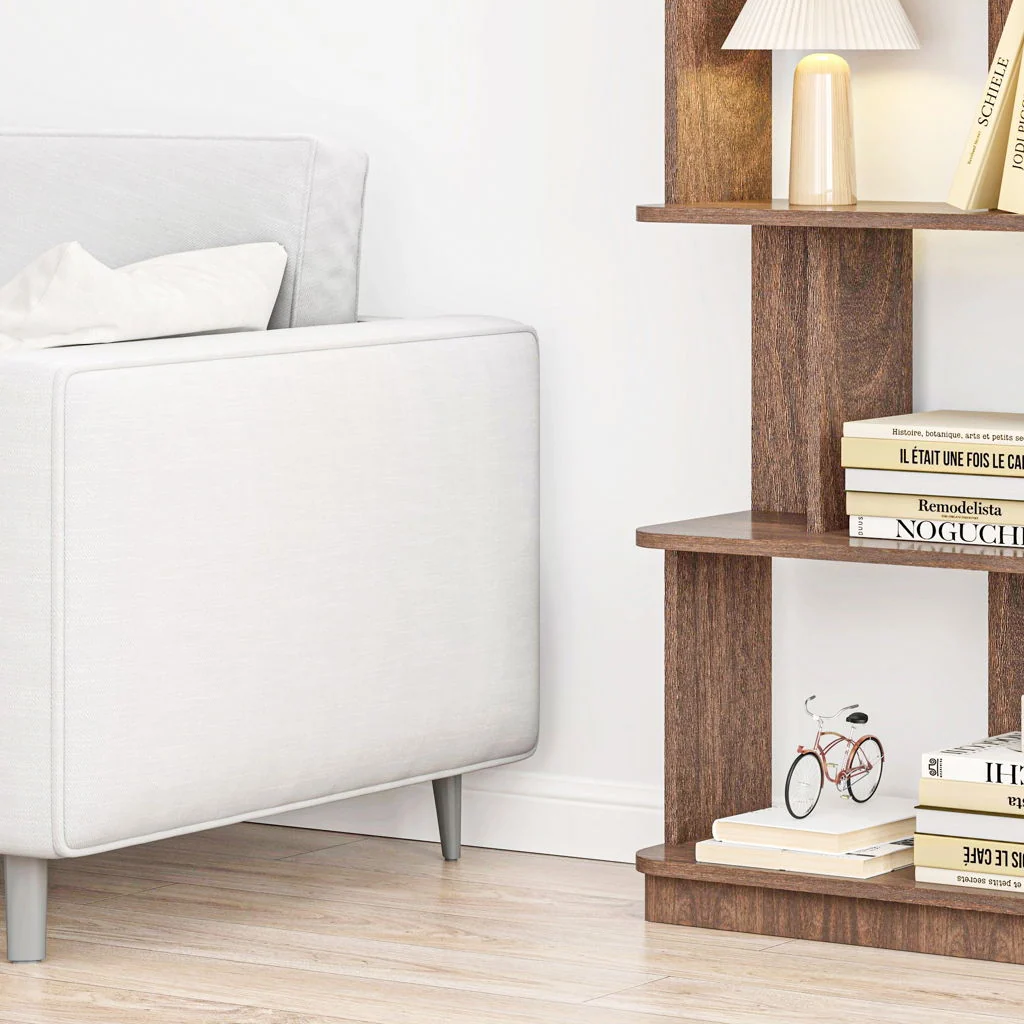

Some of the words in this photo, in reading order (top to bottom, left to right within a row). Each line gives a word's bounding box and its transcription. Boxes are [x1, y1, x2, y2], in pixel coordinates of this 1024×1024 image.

[977, 56, 1009, 127] SCHIELE
[892, 428, 923, 438] Histoire,
[965, 432, 981, 440] arts
[991, 433, 1013, 442] petits
[900, 448, 909, 464] IL
[912, 446, 941, 465] ÉTAIT
[943, 450, 964, 467] UNE
[966, 452, 989, 468] FOIS
[993, 453, 1005, 469] LE
[918, 498, 1002, 516] Remodelista
[963, 846, 993, 867] CAFÉ
[996, 849, 1008, 867] LE
[956, 875, 986, 885] secrets
[988, 878, 1011, 888] petits
